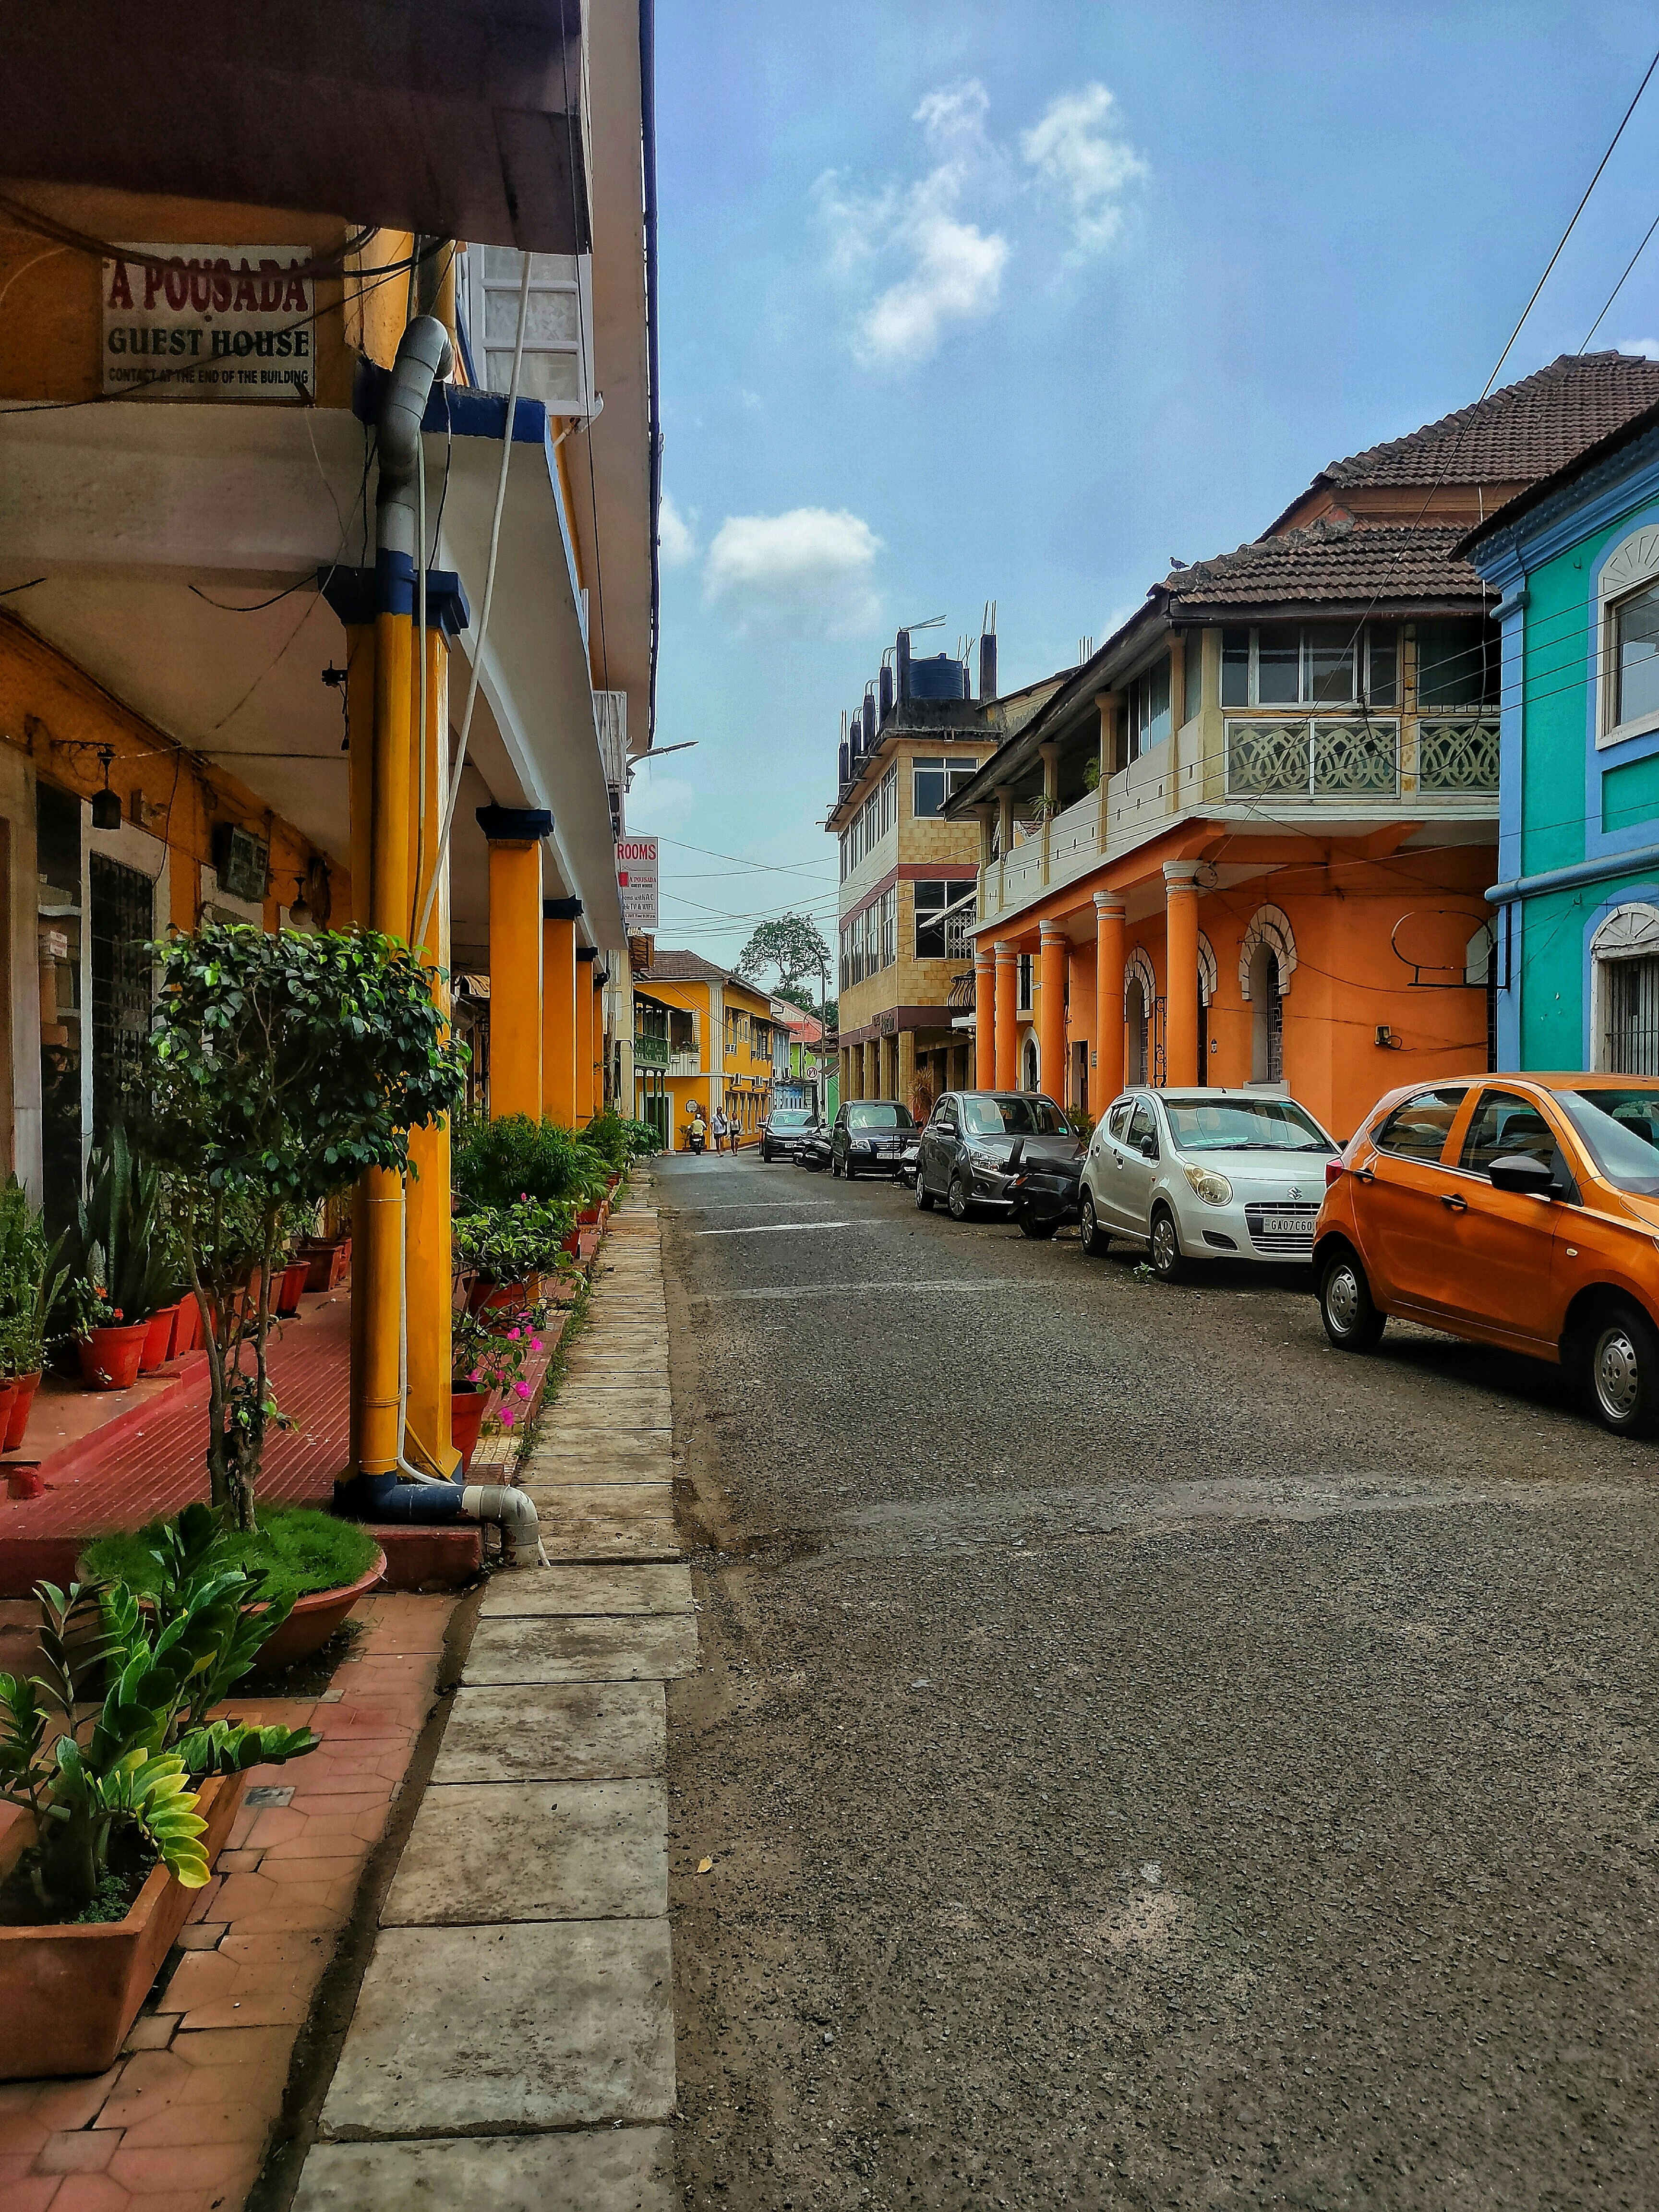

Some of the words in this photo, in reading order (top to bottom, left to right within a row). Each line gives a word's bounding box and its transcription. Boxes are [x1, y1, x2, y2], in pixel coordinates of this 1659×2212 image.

[108, 260, 134, 310] A
[144, 256, 310, 312] POUSADA
[108, 328, 203, 356] GUEST
[211, 330, 309, 357] HOUSE
[198, 370, 219, 383] END
[222, 370, 235, 384] OF
[238, 370, 257, 384] THE
[261, 370, 308, 384] BUILDING
[617, 843, 656, 860] ROOMS
[1271, 1220, 1314, 1231] GA07C60
